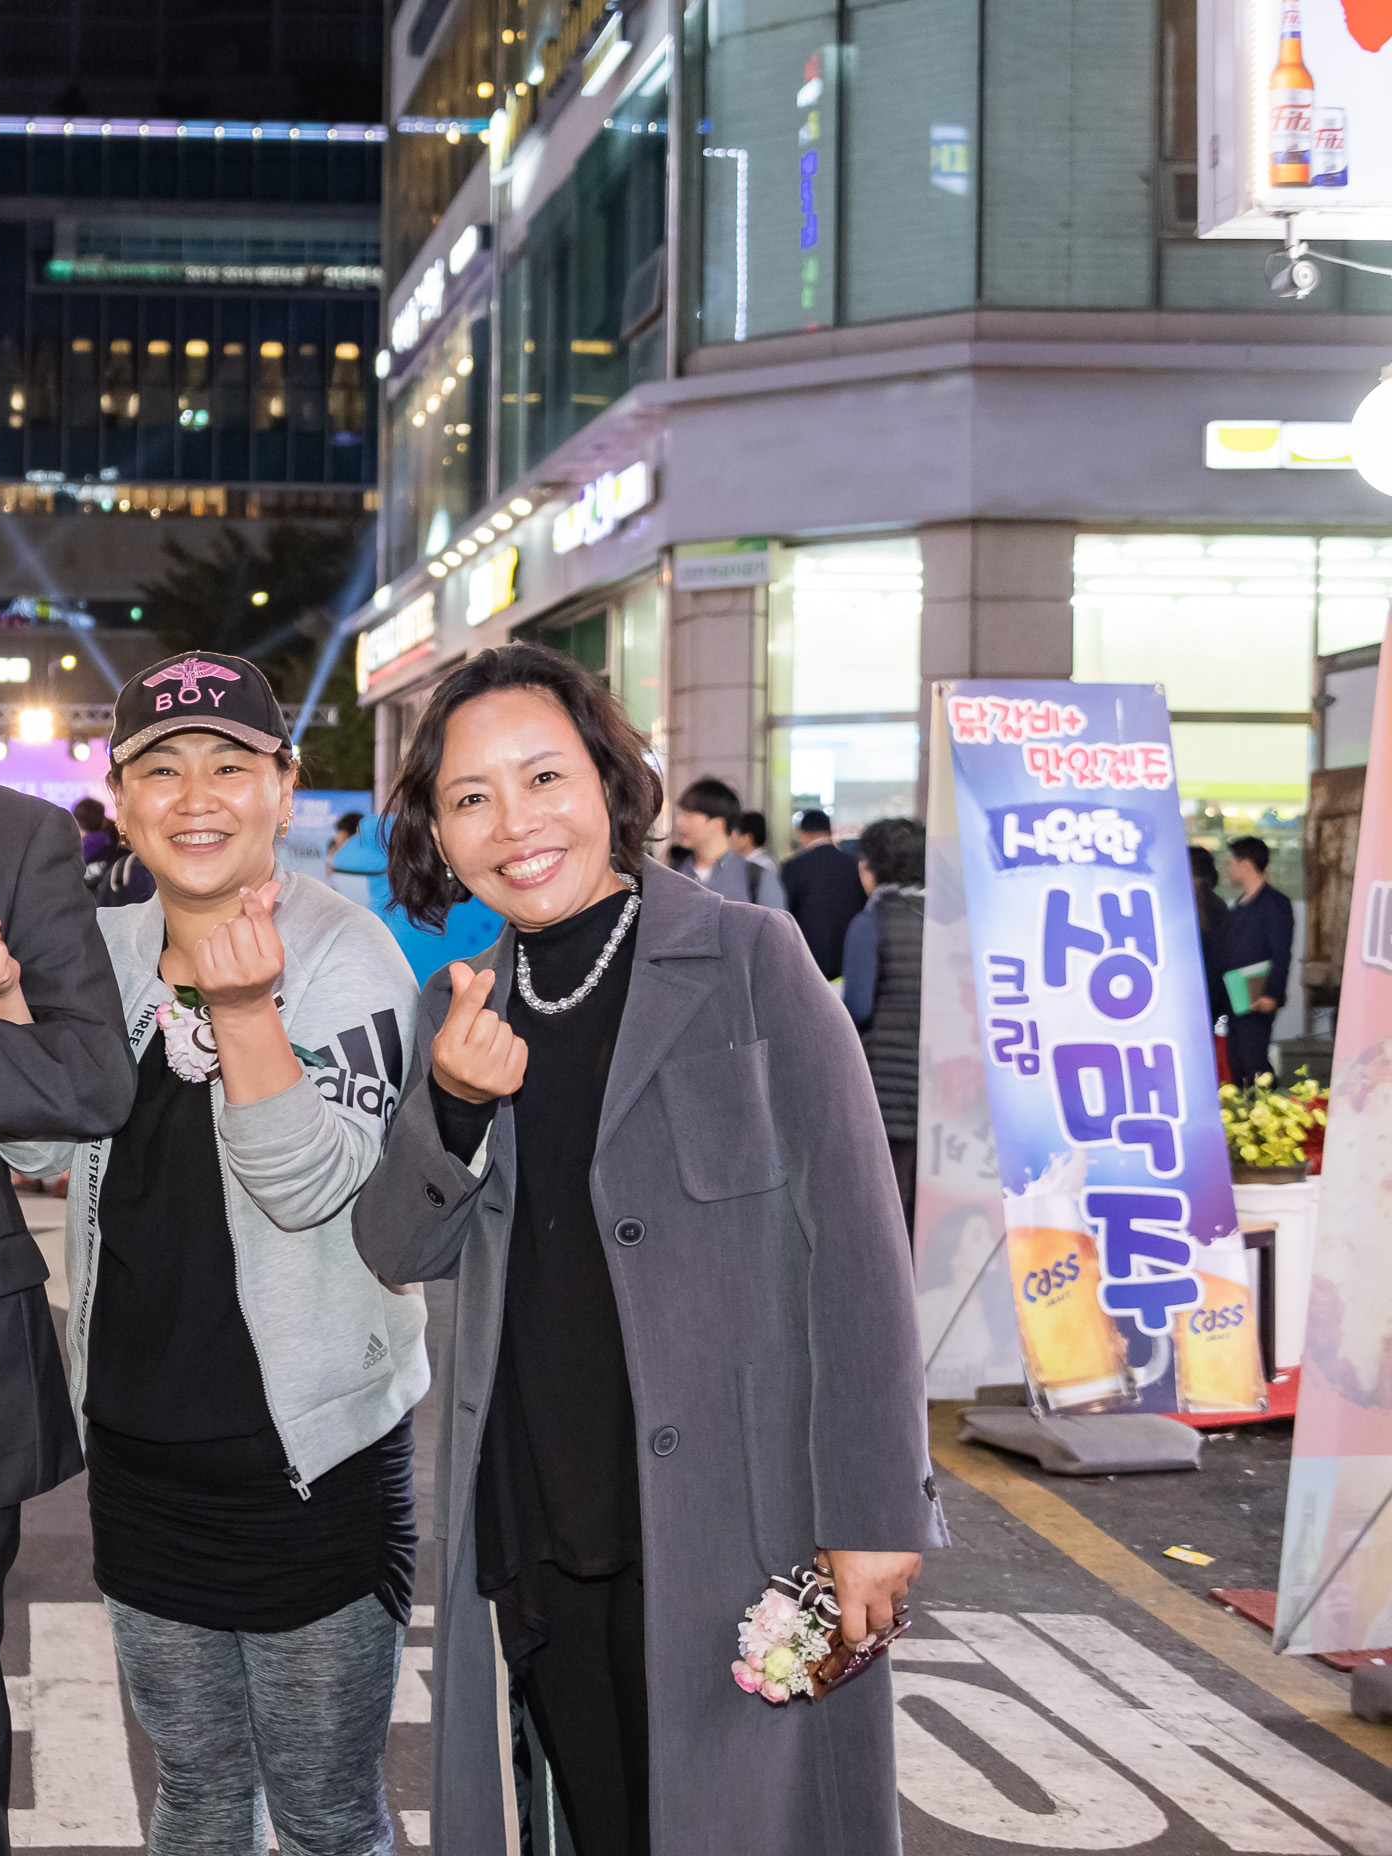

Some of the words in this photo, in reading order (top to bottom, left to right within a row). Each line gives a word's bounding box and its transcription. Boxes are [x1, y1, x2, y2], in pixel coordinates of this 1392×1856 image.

[1272, 104, 1312, 131] Fitz
[1314, 127, 1344, 149] Fitz
[155, 686, 226, 712] BOY
[1003, 809, 1142, 865] 시원한
[129, 1003, 159, 1047] THREE
[985, 952, 1042, 1076] 크림
[1042, 886, 1200, 1332] 생맥주
[87, 1153, 101, 1227] STREIFEN
[77, 1281, 92, 1338] BANDES
